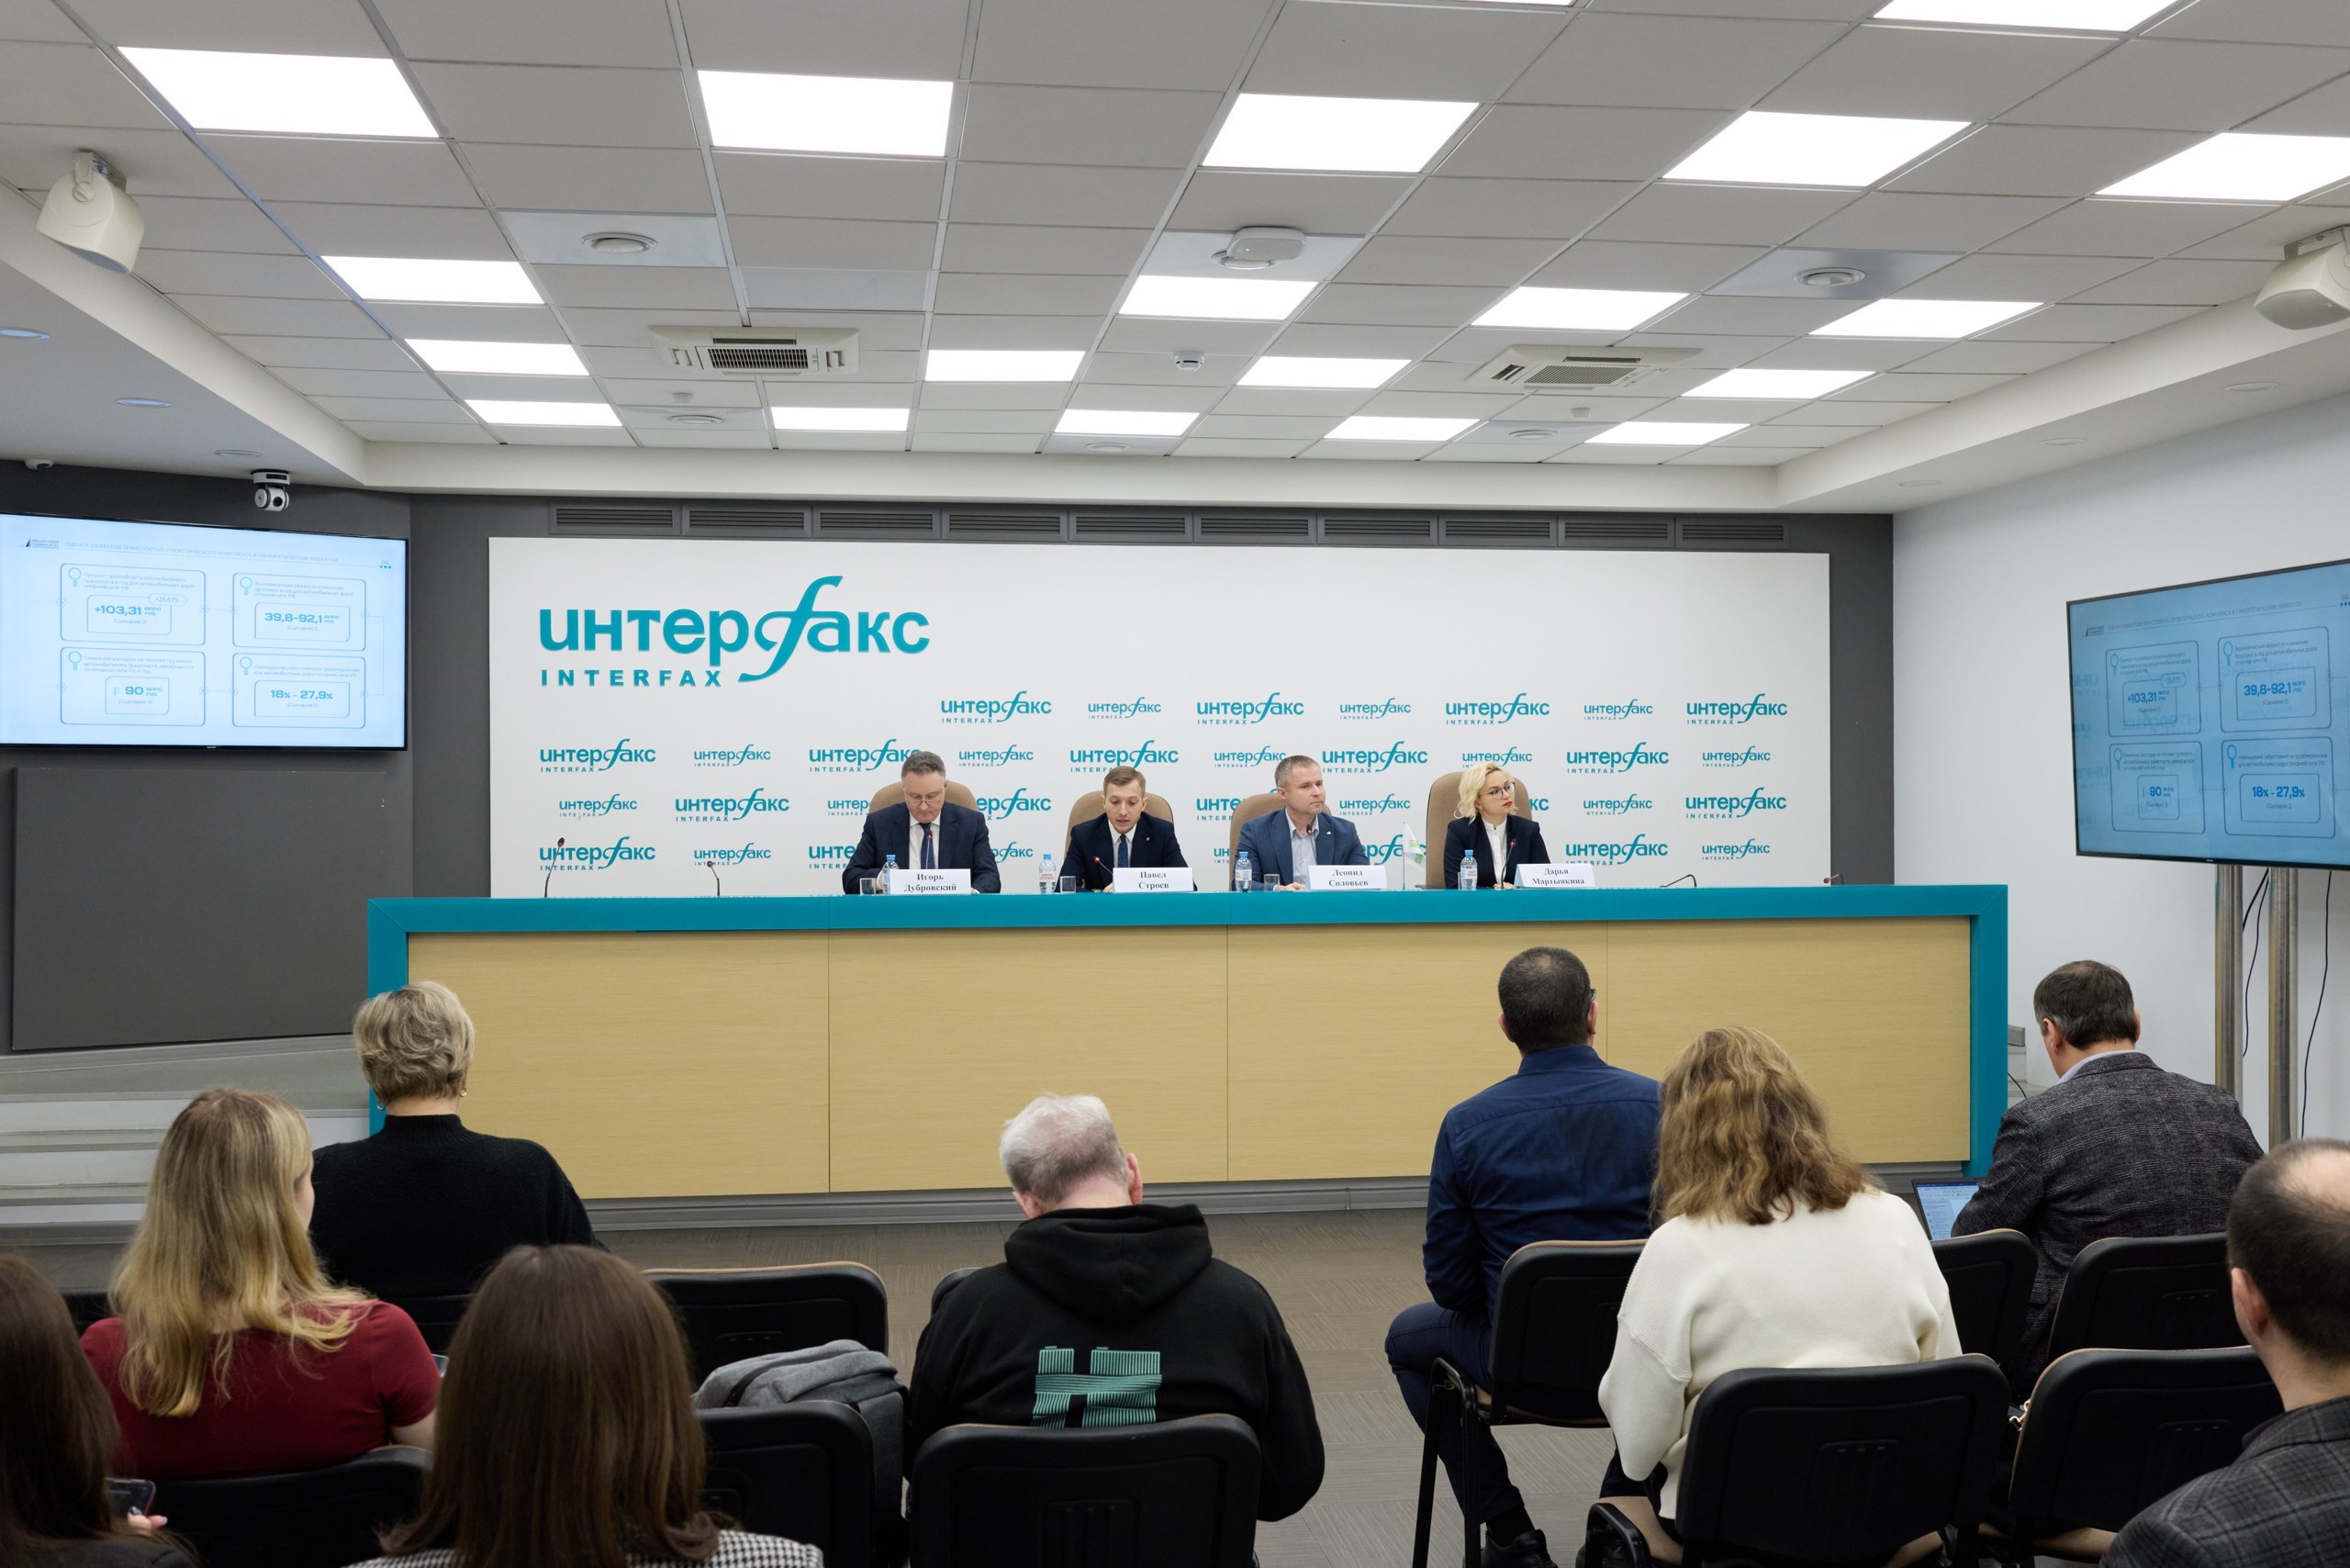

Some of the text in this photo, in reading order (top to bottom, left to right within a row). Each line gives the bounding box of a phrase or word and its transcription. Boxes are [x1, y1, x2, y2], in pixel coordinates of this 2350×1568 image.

[95, 605, 142, 616] +103,31
[539, 576, 931, 684] интерфакс
[541, 669, 722, 688] INTERFAX
[125, 686, 144, 696] 90
[941, 690, 1052, 722] интерфакс
[1088, 696, 1161, 719] интерфакс
[1196, 692, 1305, 723] интерфакс
[1339, 698, 1411, 719] интерфакс
[1446, 692, 1550, 723] интерфакс
[1583, 699, 1653, 720] интерфакс
[1686, 693, 1788, 723] интерфакс
[540, 738, 656, 771] интерфакс
[694, 744, 771, 767] интерфакс
[958, 745, 1035, 767] интерфакс
[1321, 741, 1428, 772] интерфакс
[1567, 742, 1670, 773] интерфакс
[1702, 746, 1771, 767] интерфакс
[2149, 786, 2162, 797] 90
[559, 793, 638, 816] интерфакс
[675, 787, 789, 821] интерфакс
[1339, 793, 1411, 814] интерфакс
[1583, 794, 1653, 814] интерфакс
[1685, 787, 1787, 819] интерфакс
[694, 843, 772, 865] интерфакс
[1565, 834, 1669, 865] интерфакс
[1702, 838, 1771, 860] интерфакс
[917, 873, 945, 882] Игорь
[1332, 868, 1363, 878] Леонид
[1532, 878, 1585, 887] Мартынкина
[1544, 868, 1569, 876] Дарья
[903, 884, 957, 893] Дубровский
[1138, 881, 1169, 890] Строев
